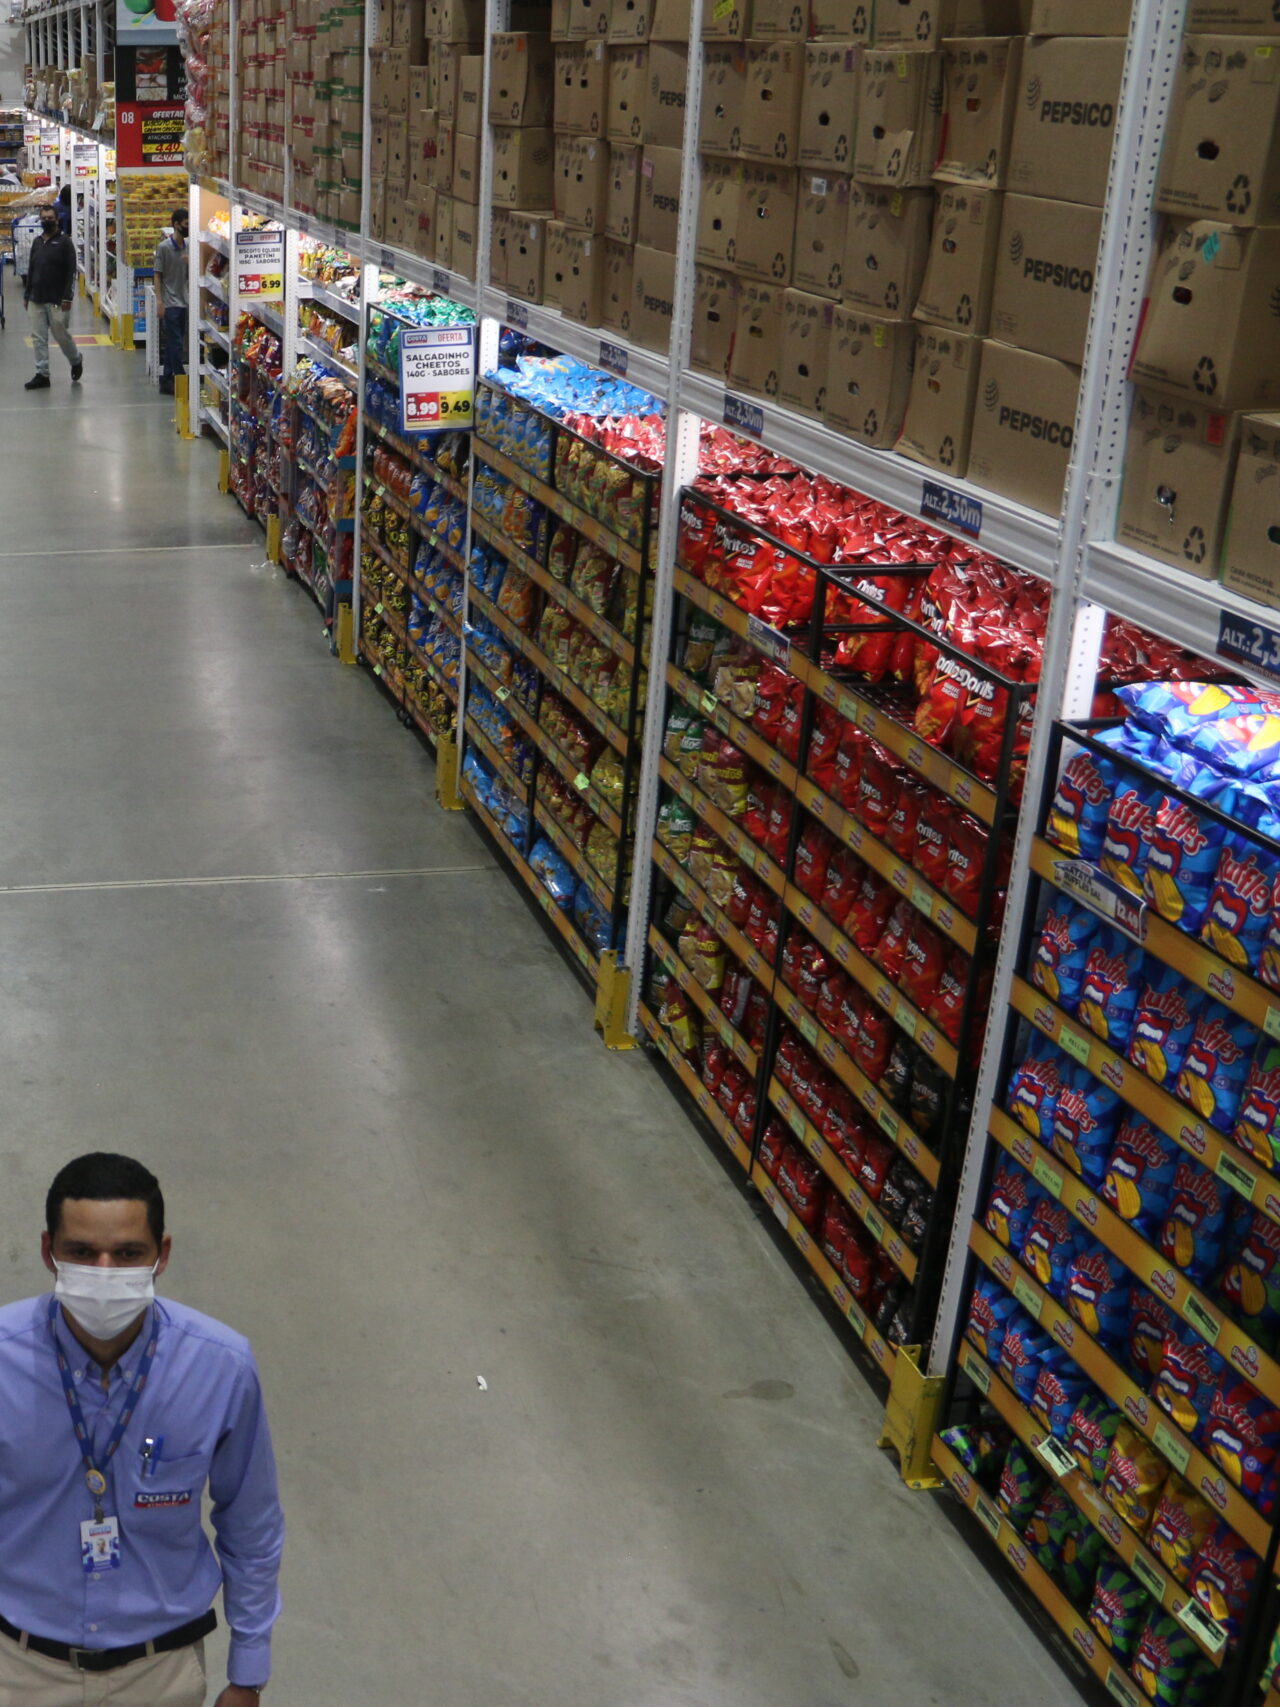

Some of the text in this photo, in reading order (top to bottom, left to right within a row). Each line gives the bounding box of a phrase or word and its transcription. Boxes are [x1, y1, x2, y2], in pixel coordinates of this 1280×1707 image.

[659, 91, 685, 107] PEPSI
[121, 111, 135, 124] 08
[1040, 100, 1113, 128] PEPSICO
[1023, 257, 1093, 293] PEPSICO
[261, 279, 281, 289] 6,99
[437, 332, 463, 342] OFERTA
[405, 351, 469, 362] SALGADINHO
[415, 360, 461, 369] CHEETOS
[432, 367, 470, 377] SABORES
[407, 400, 470, 416] 8,99 9,49
[999, 406, 1074, 449] PEPSICO
[1163, 1330, 1219, 1387] Ruffles
[1071, 1407, 1106, 1450] Ruffles
[137, 1492, 189, 1503] COSTA
